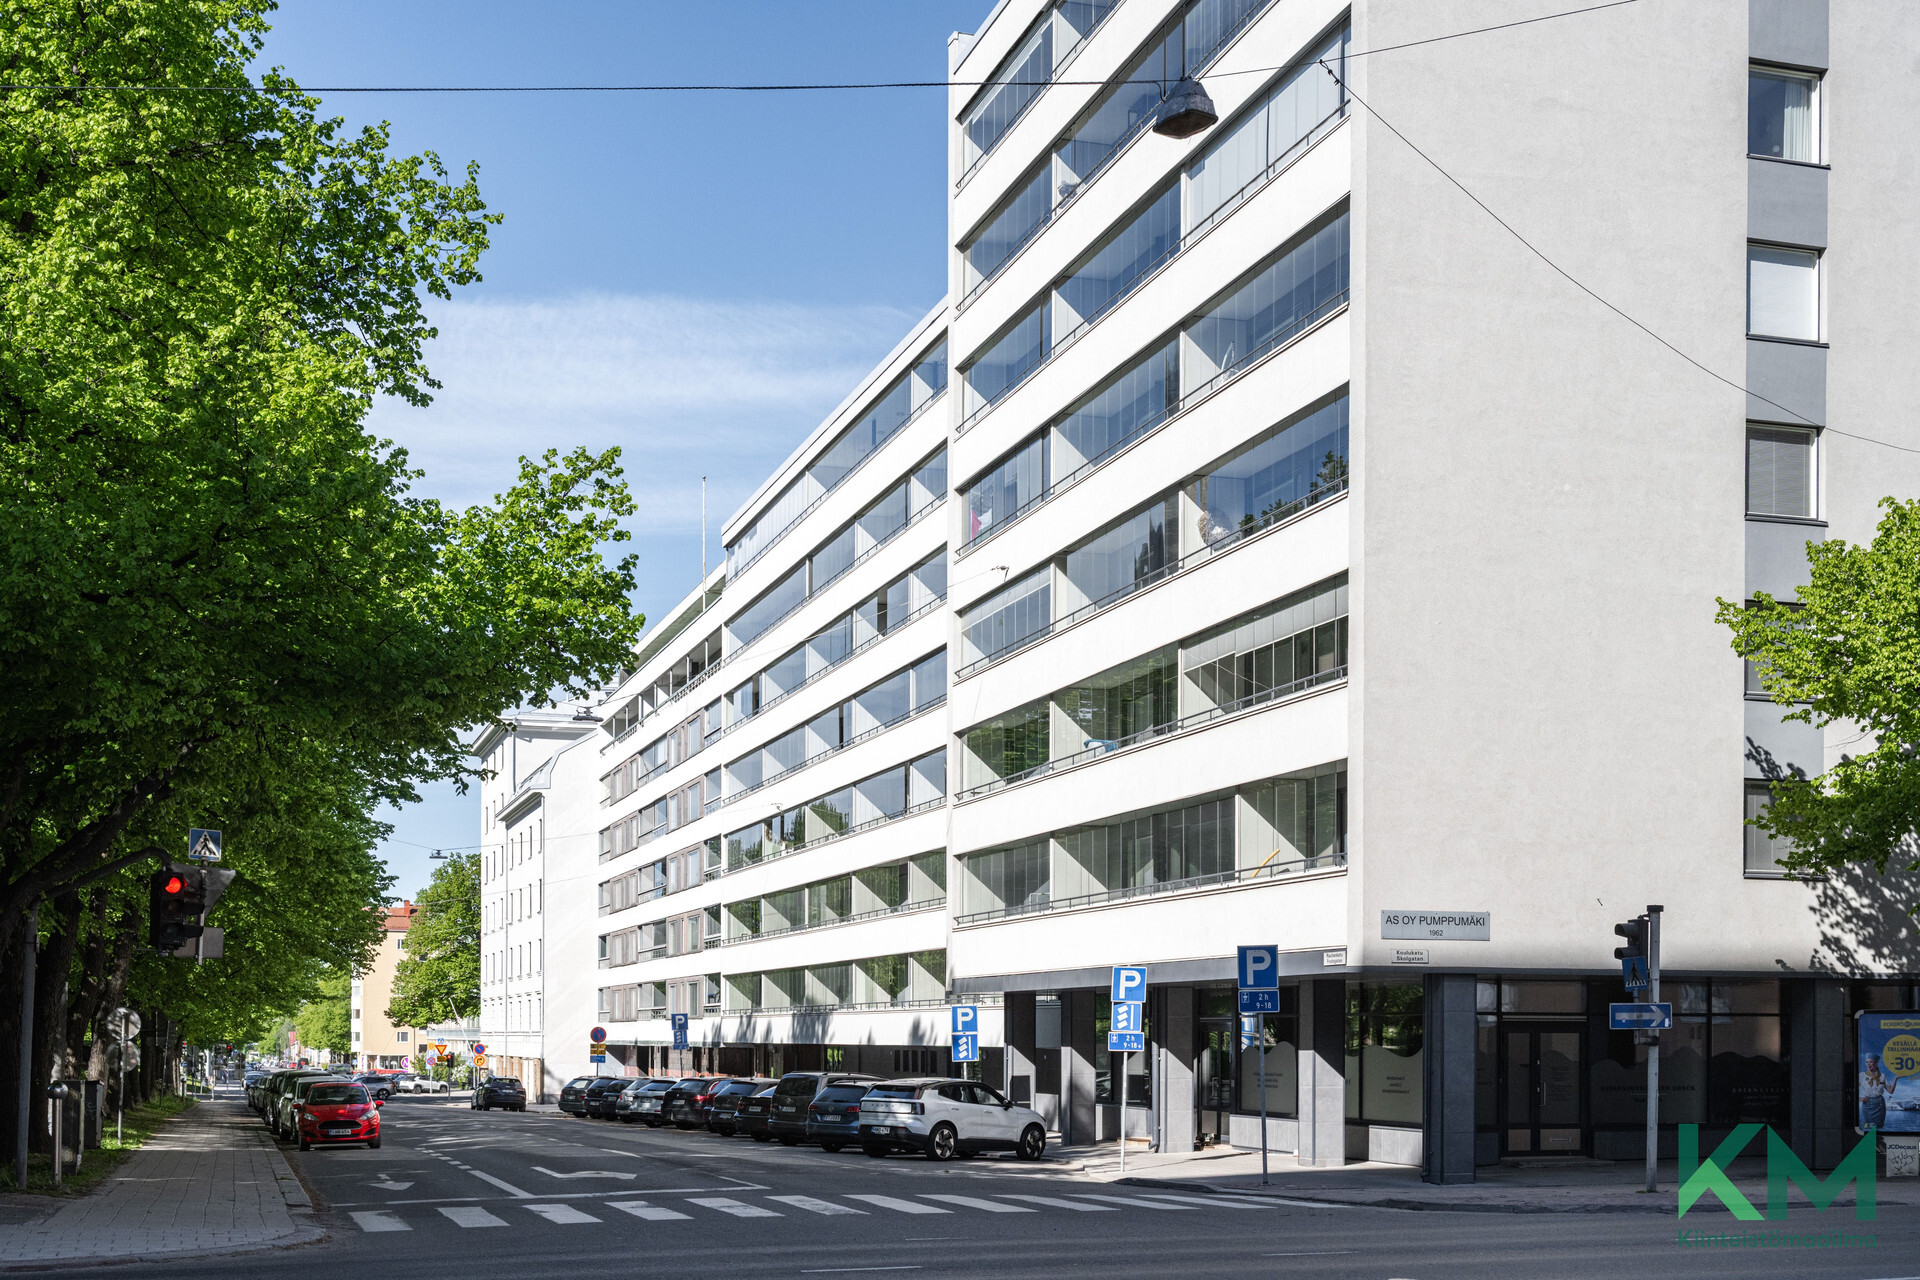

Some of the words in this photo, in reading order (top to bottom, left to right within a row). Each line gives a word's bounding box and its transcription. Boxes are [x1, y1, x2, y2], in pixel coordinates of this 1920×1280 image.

[1385, 915, 1399, 925] AS
[1402, 915, 1416, 925] OY
[1419, 915, 1485, 926] PUMPPUMÄKI
[1246, 949, 1271, 985] P
[1119, 970, 1141, 999] P
[675, 1015, 685, 1029] P
[957, 1008, 974, 1031] P
